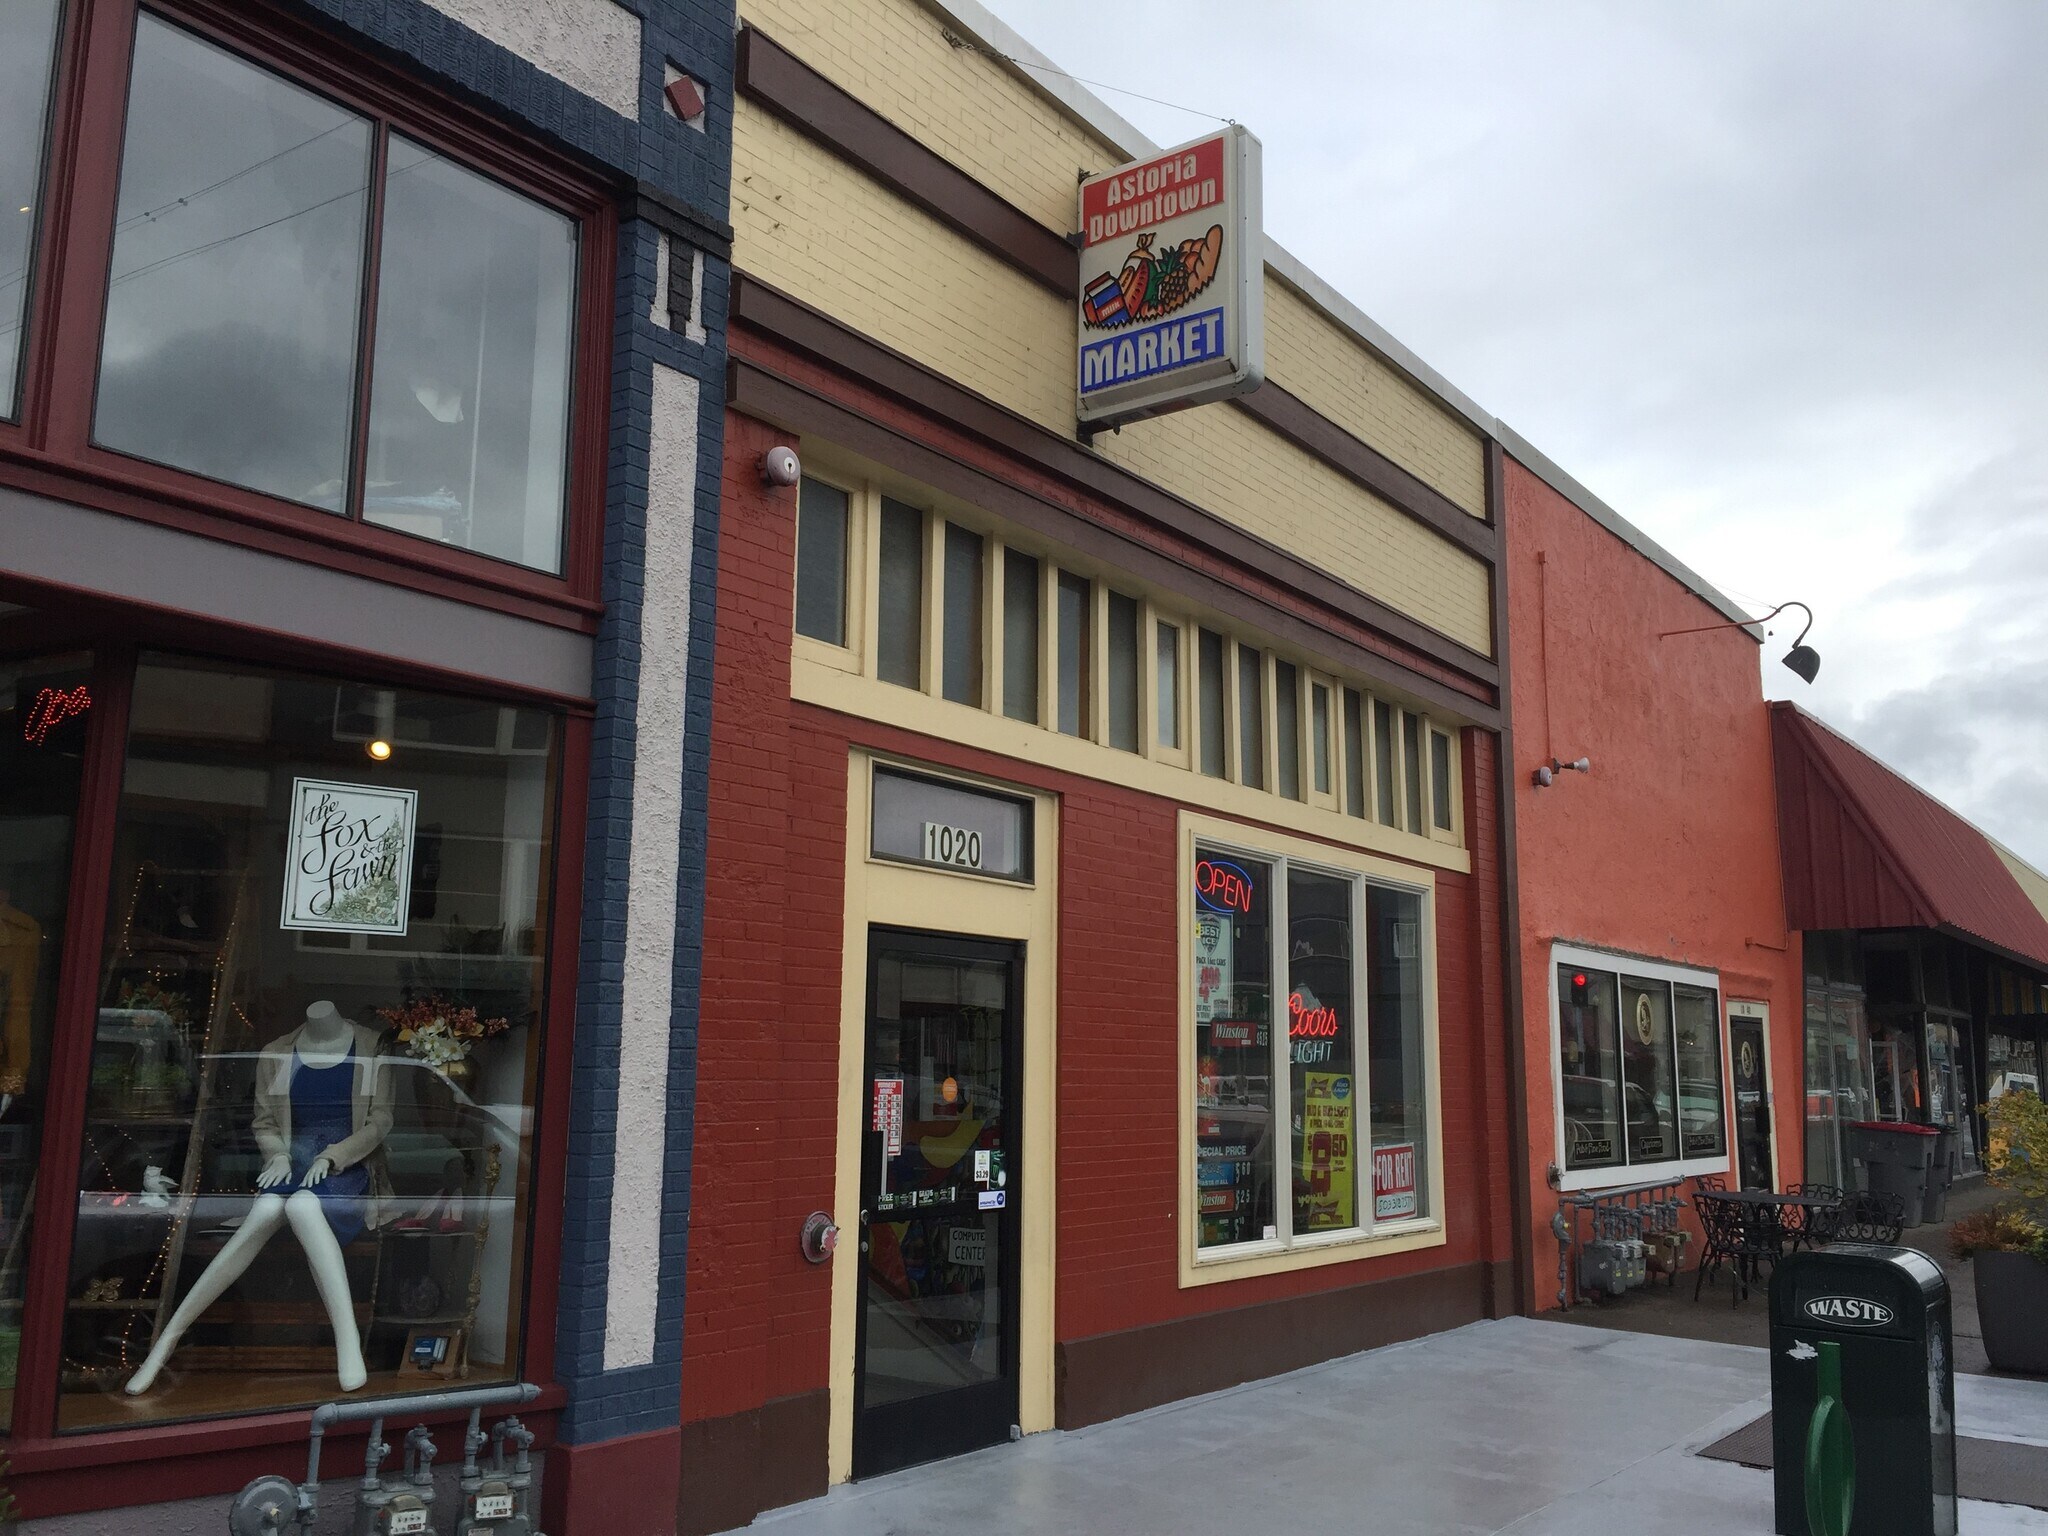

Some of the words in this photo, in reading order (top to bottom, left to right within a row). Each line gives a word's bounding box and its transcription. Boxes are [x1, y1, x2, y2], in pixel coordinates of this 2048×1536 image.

[1107, 153, 1197, 207] Astoria
[1089, 177, 1216, 243] Downtown
[1084, 312, 1220, 387] MARKET
[929, 824, 981, 868] 1020
[1195, 861, 1252, 913] OPEN
[1215, 1022, 1249, 1039] Winston
[1288, 992, 1338, 1036] Coors
[1225, 1144, 1247, 1156] PRICE
[1376, 1153, 1394, 1191] FOR
[1395, 1151, 1413, 1189] RENT
[952, 1230, 985, 1241] COMPUTE
[1809, 1299, 1889, 1322] WASTE
